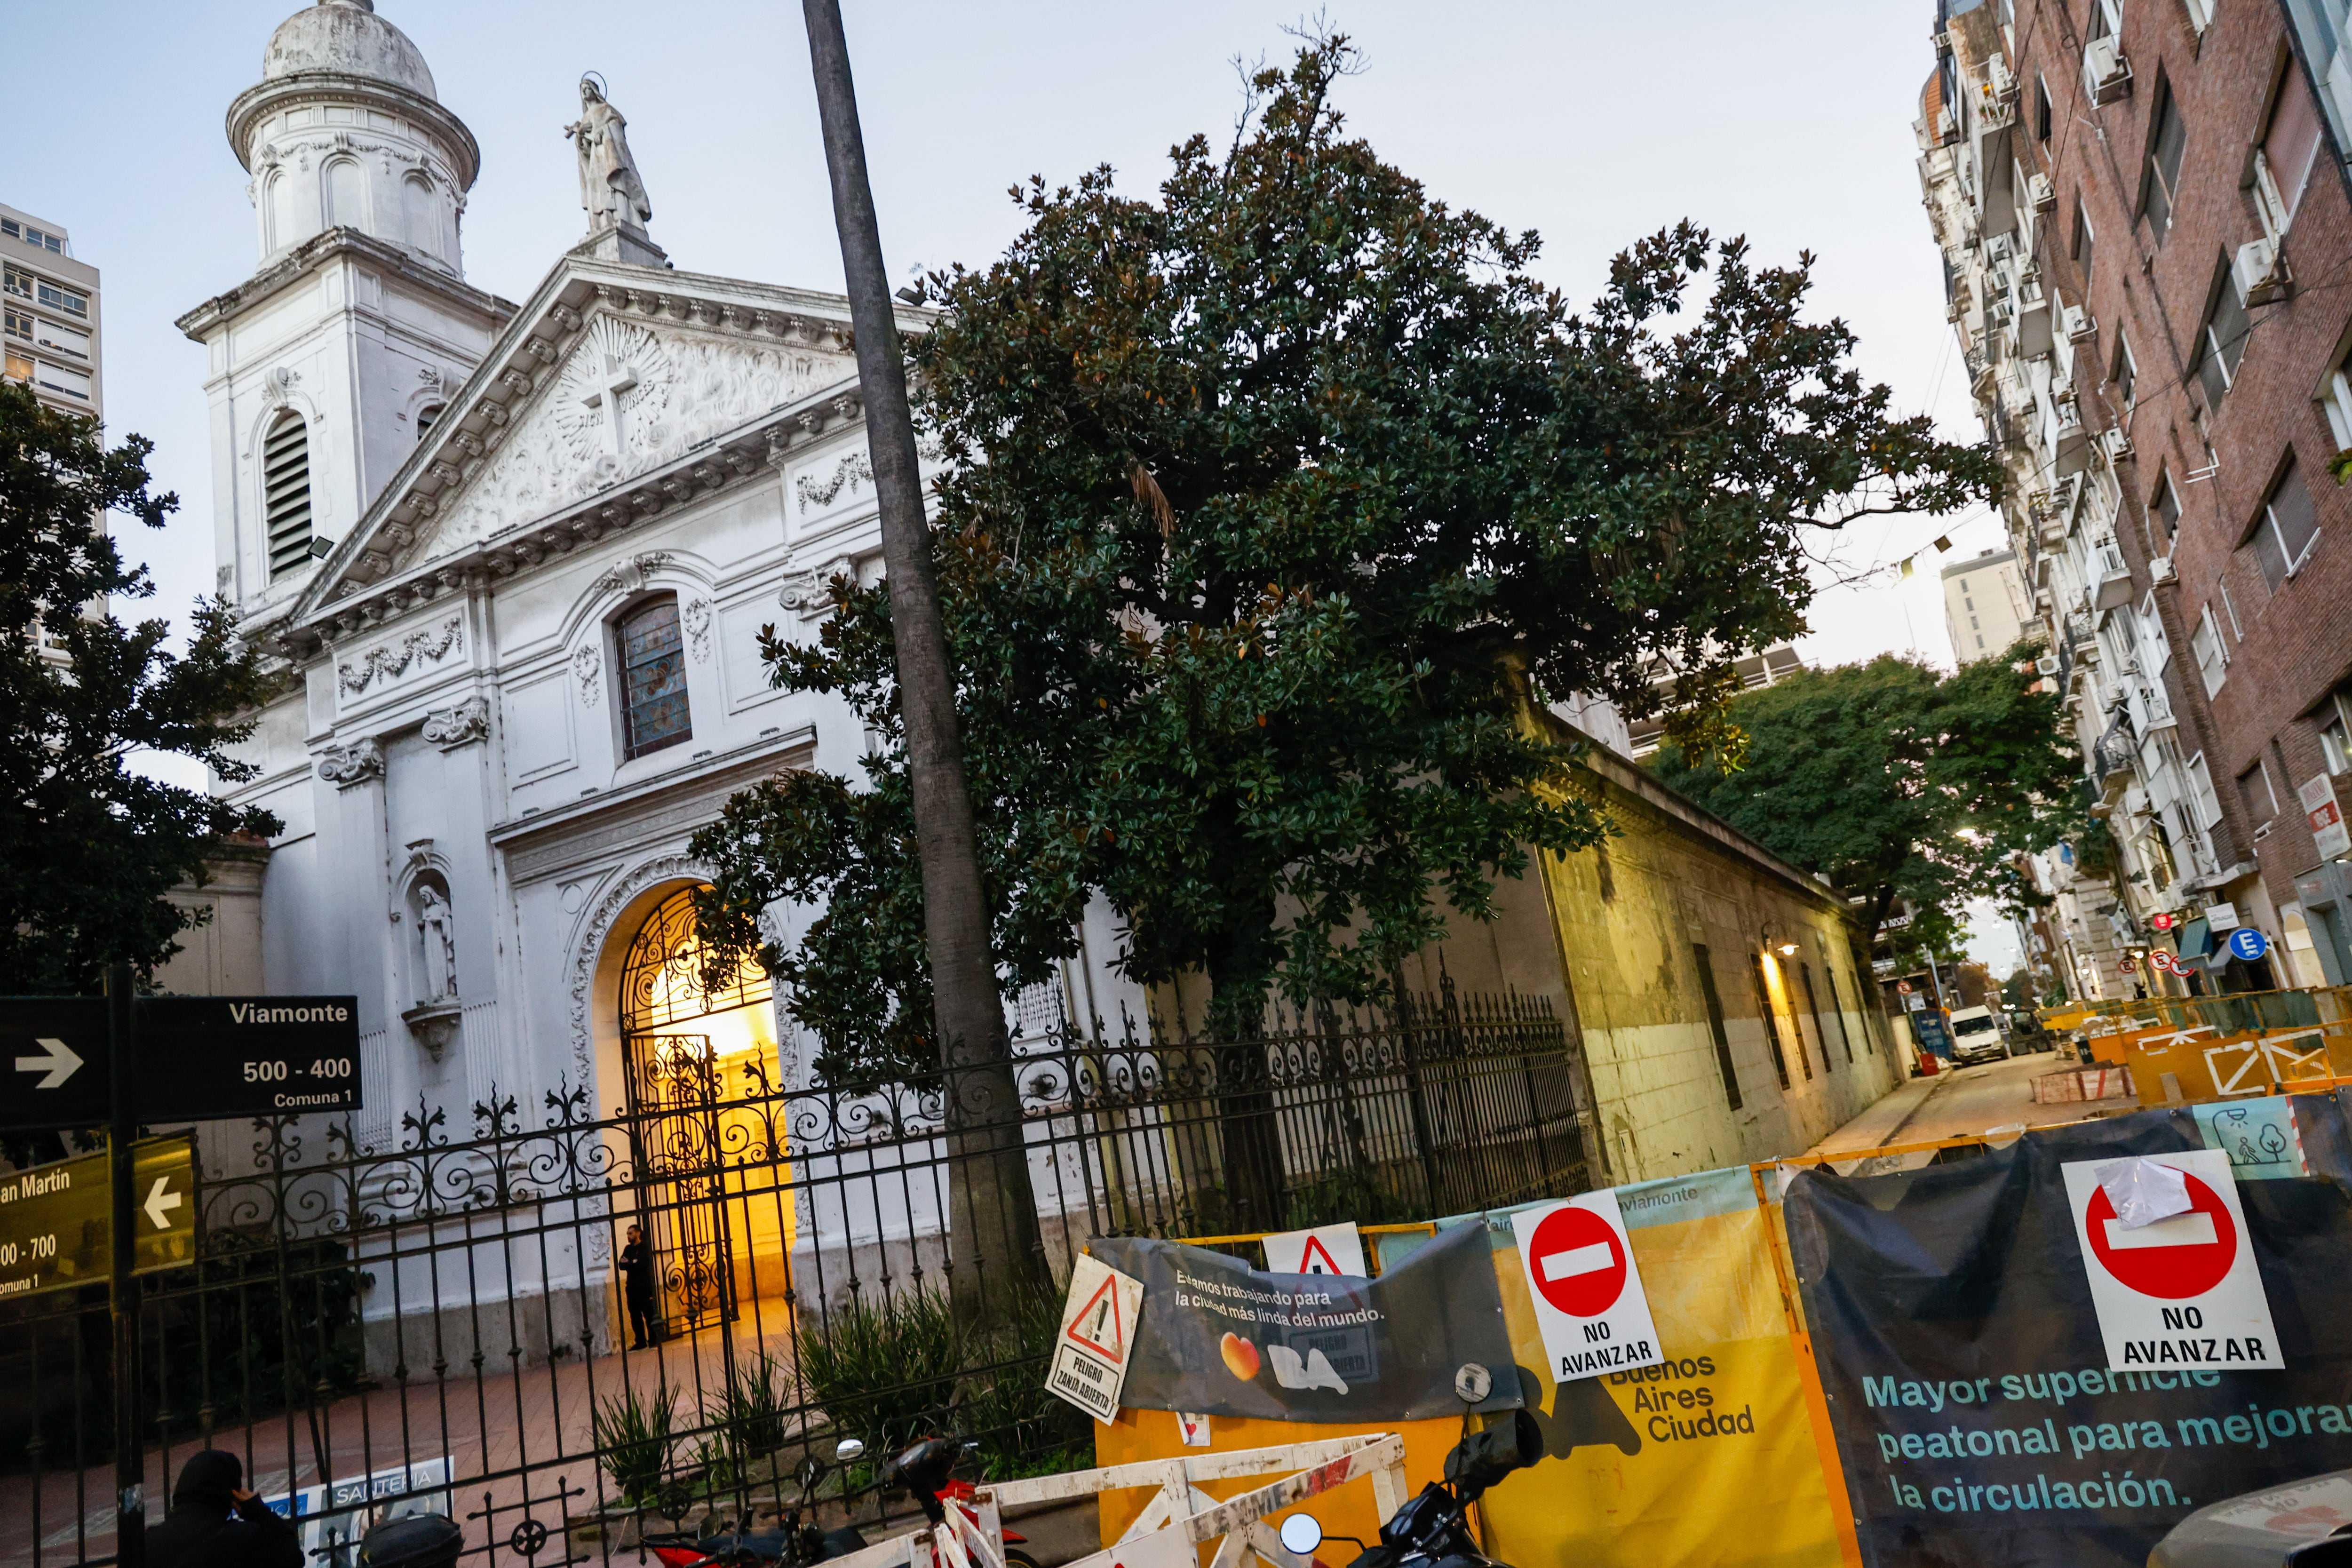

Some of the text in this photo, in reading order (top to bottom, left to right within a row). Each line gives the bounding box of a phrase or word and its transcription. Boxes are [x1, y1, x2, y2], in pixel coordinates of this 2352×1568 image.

[229, 1003, 348, 1024] Viamonte
[244, 1060, 287, 1082] 500
[310, 1058, 351, 1079] 400
[274, 1089, 351, 1107] Comuna 1
[0, 1168, 70, 1204] an Martín
[1618, 1187, 1698, 1213] viamonte
[0, 1242, 17, 1266] 00
[30, 1234, 56, 1260] 700
[0, 1273, 39, 1295] omuna 1
[1222, 1282, 1292, 1306] trabajando
[1294, 1292, 1332, 1308] para
[1176, 1290, 1385, 1327] la ciudad más linda del mundo.
[2161, 1306, 2203, 1330] NO
[1583, 1321, 1611, 1343] NO
[1562, 1340, 1653, 1376] AVANZAR
[2124, 1337, 2267, 1364] AVANZAR
[1073, 1356, 1103, 1384] PELIGRO
[1057, 1370, 1110, 1411] ZANJA ABIERTA
[1635, 1386, 1714, 1414] Aires
[1862, 1375, 1991, 1413] Mayor
[1648, 1404, 1755, 1442] Ciudad
[1877, 1418, 2060, 1464] peatonal
[2067, 1420, 2171, 1460] para
[1889, 1474, 1926, 1510] la
[1931, 1470, 2192, 1512] circulación.
